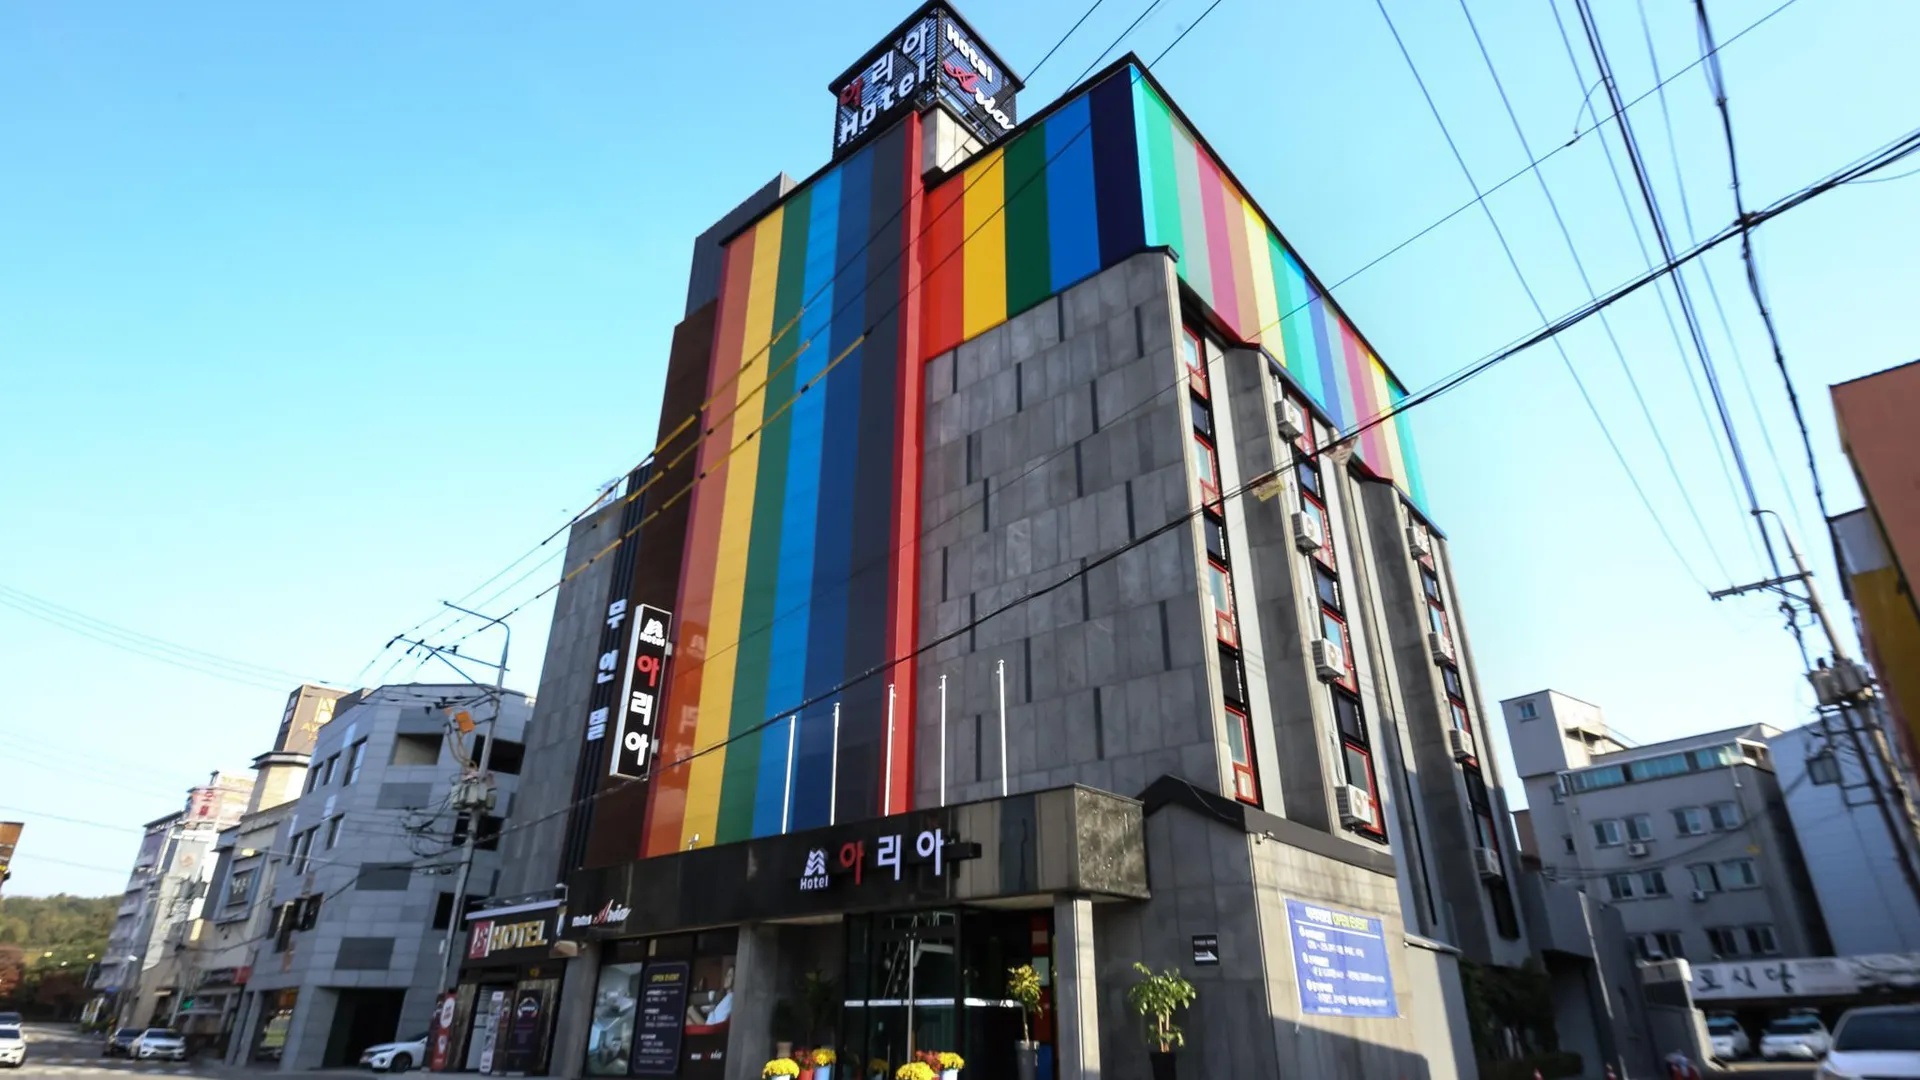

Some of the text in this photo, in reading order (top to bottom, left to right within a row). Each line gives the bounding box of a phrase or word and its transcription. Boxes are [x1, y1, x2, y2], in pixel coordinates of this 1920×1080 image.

[840, 17, 929, 110] 아리아
[947, 23, 992, 83] Hotel
[838, 59, 926, 147] Hotel
[640, 632, 665, 647] Hotel
[625, 655, 660, 766] 아리아
[800, 875, 829, 891] Hotel
[840, 828, 944, 886] 아리아
[489, 920, 549, 952] HOTEL
